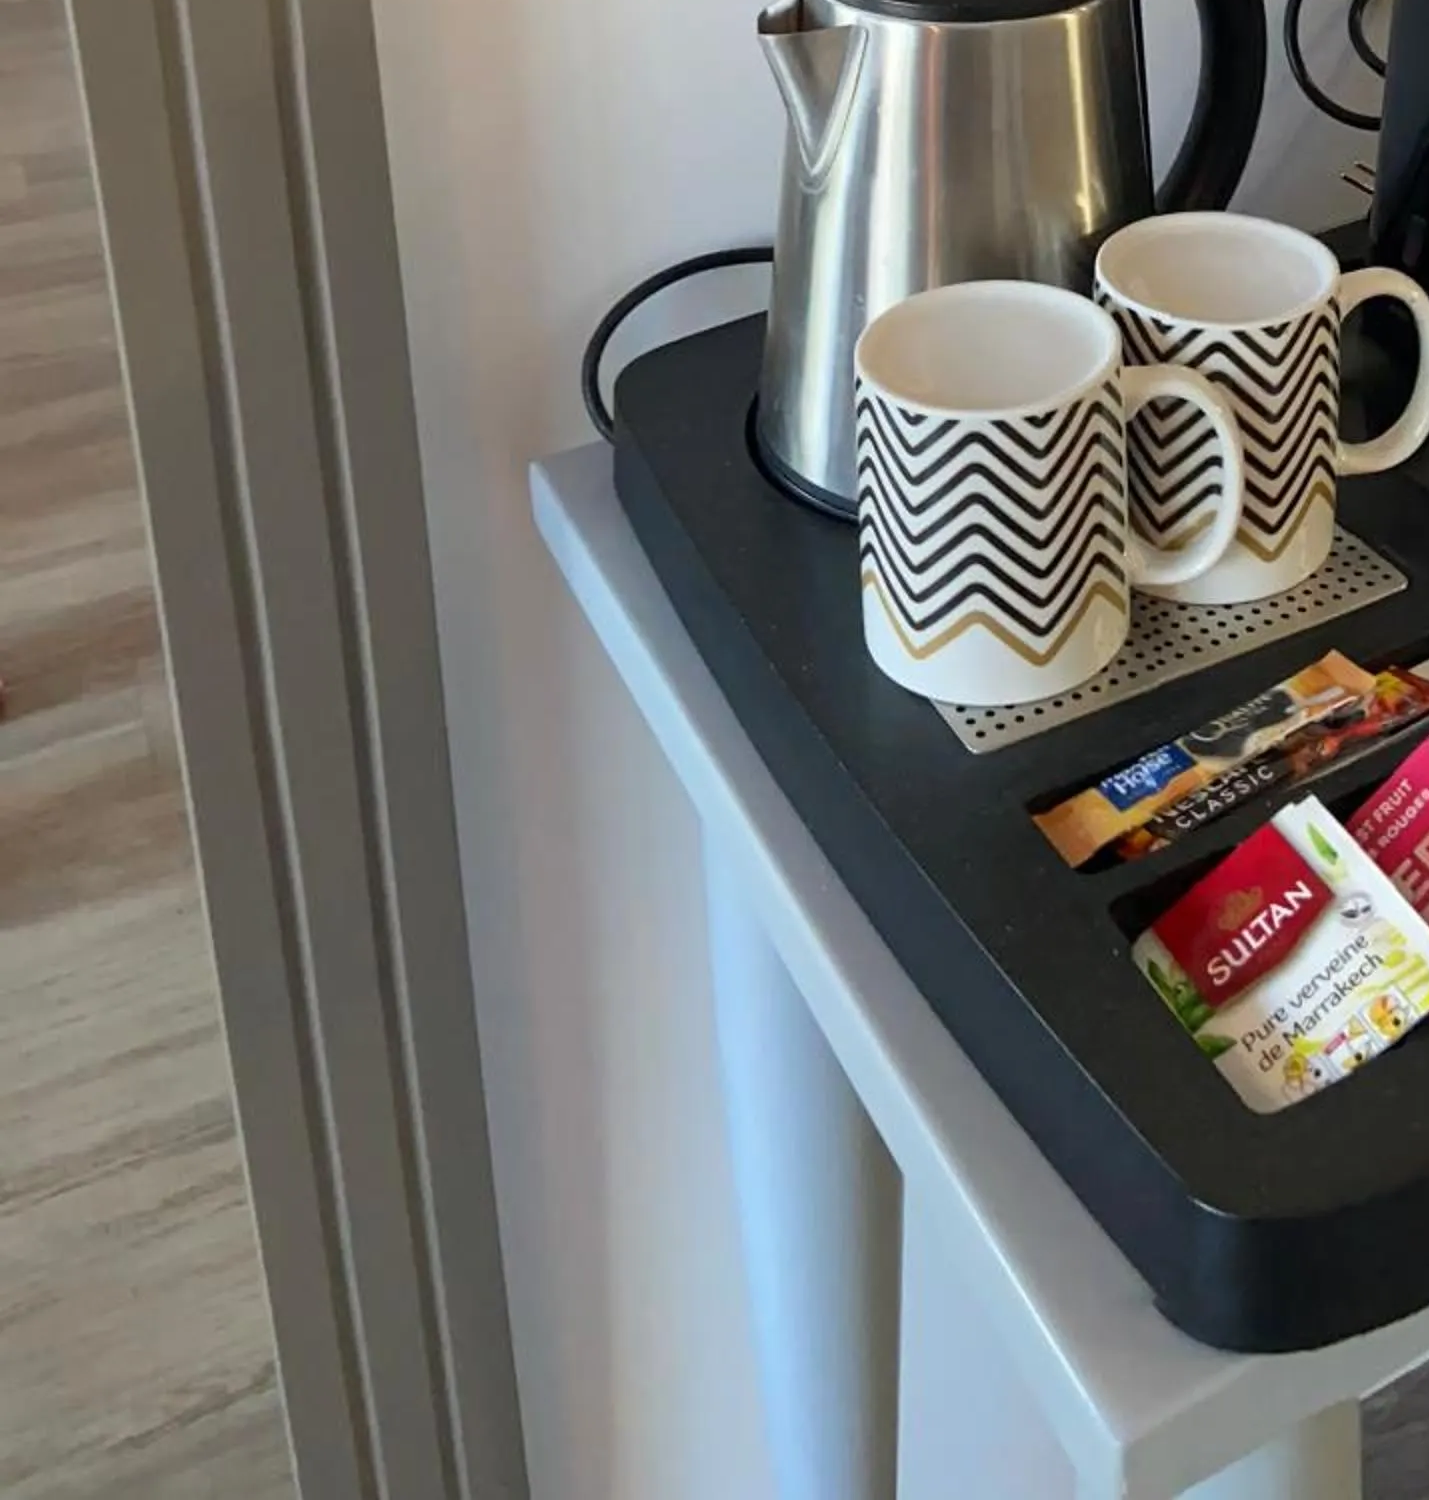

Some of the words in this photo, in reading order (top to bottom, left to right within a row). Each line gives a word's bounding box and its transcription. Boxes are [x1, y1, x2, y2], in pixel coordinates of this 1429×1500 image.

[1175, 765, 1273, 828] CLASSIC
[1373, 777, 1413, 822] FRUIT
[1207, 880, 1313, 987] SULTAN
[1240, 1005, 1288, 1052] Pure
[1289, 934, 1370, 1008] verveine
[1258, 1048, 1283, 1074] de
[1283, 952, 1385, 1047] Marrakech
